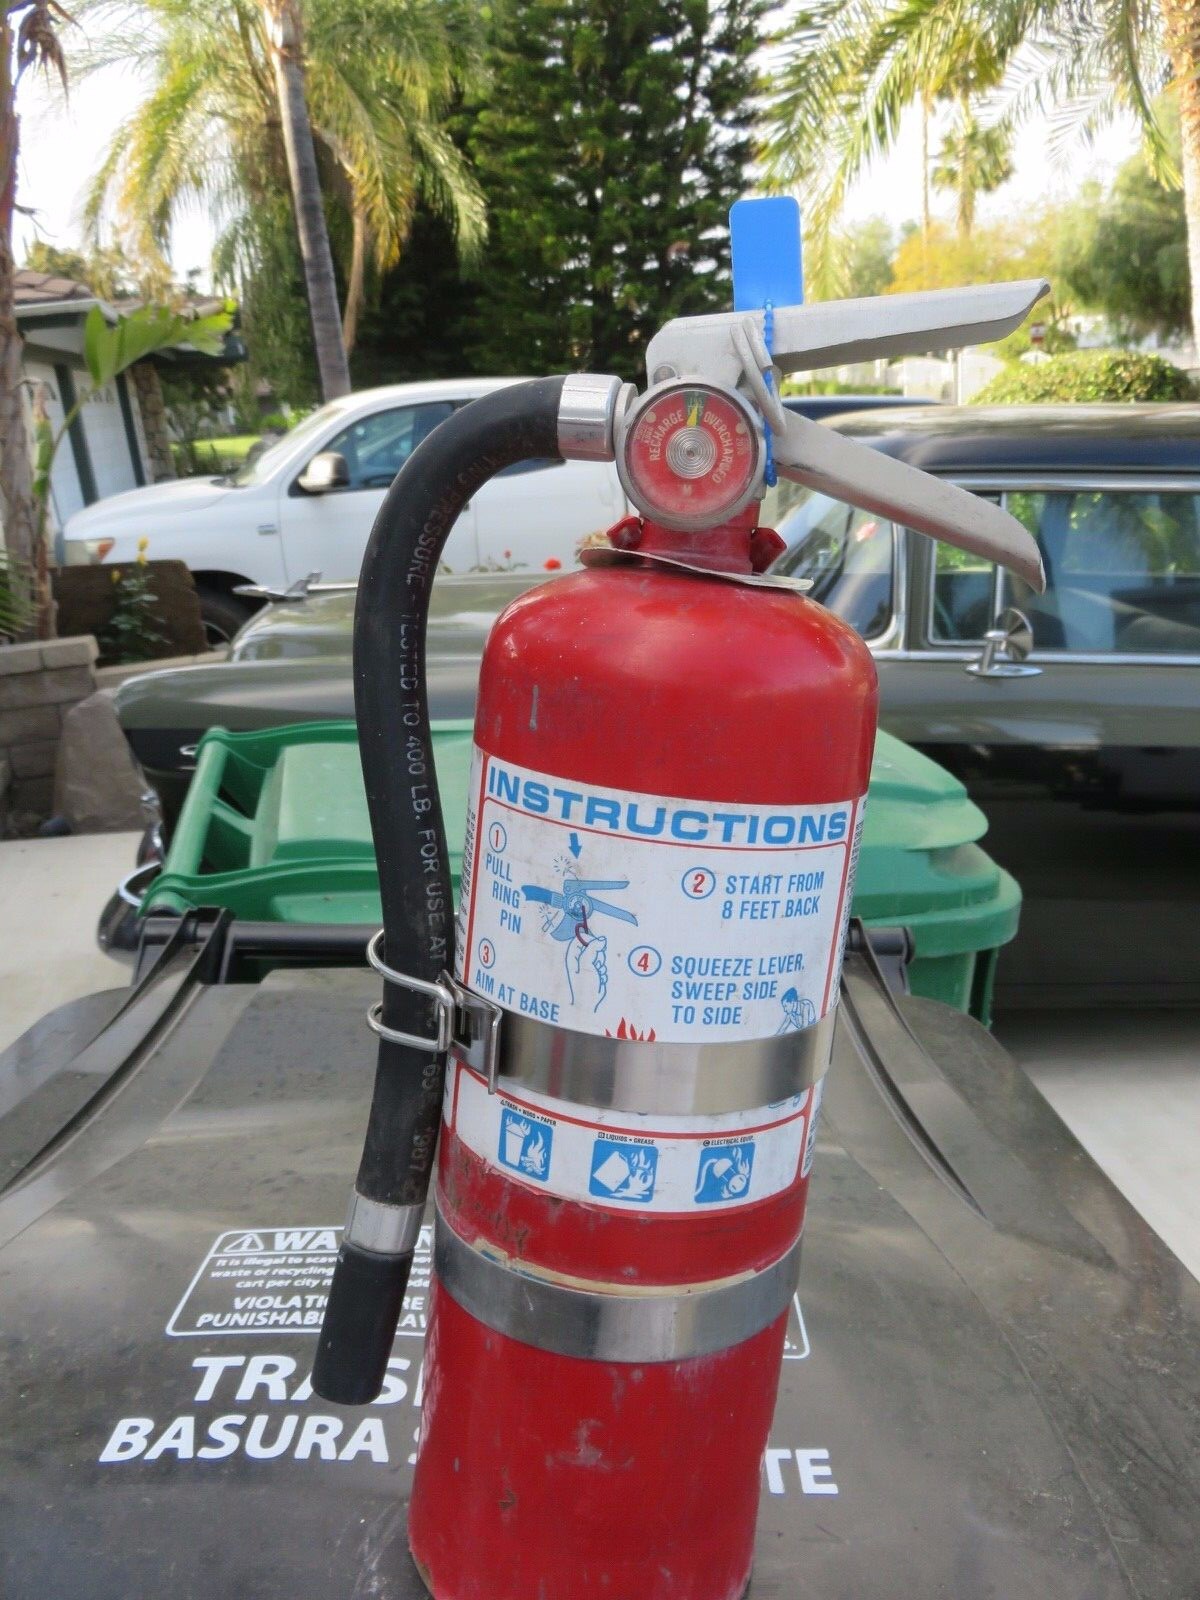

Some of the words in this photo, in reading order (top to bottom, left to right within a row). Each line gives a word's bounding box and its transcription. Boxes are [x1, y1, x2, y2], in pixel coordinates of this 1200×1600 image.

[650, 410, 684, 461] RECHARGE
[703, 411, 733, 484] OVERCHARGED
[402, 700, 420, 727] TO
[406, 735, 426, 776] 400
[411, 783, 432, 820] LB.
[488, 766, 848, 845] INSTRUCTIONS
[418, 829, 440, 874] FOR
[485, 854, 513, 883] PULL
[492, 883, 521, 909] RING
[725, 873, 784, 896] START
[788, 870, 824, 894] FROM
[426, 882, 445, 927] USE
[721, 901, 732, 920] 8
[738, 898, 782, 920] FEET
[785, 896, 820, 918] BACK
[500, 909, 522, 934] PIN
[429, 936, 448, 964] AT
[671, 955, 754, 978] SQUEEZE
[757, 953, 806, 974] LEVER.
[475, 970, 496, 993] AIM
[497, 978, 516, 1002] AT
[518, 991, 561, 1022] BASE
[671, 978, 738, 1001] SWEEP
[742, 977, 778, 999] SIDE
[671, 1004, 699, 1025] TO
[702, 1004, 742, 1024] SIDE
[522, 1109, 536, 1119] WOOD
[540, 1115, 557, 1127] PAPER
[606, 1134, 628, 1143] LIQUIDS
[711, 1137, 739, 1146] ELECTRICAL
[210, 1268, 251, 1278] waste
[254, 1268, 268, 1277] or
[271, 1266, 335, 1279] recycling
[229, 1257, 240, 1266] is
[242, 1256, 285, 1267] illegal
[287, 1256, 303, 1265] to
[235, 1279, 265, 1289] cart
[265, 1279, 291, 1290] per
[293, 1277, 320, 1290] city
[99, 1415, 390, 1463] BASURA
